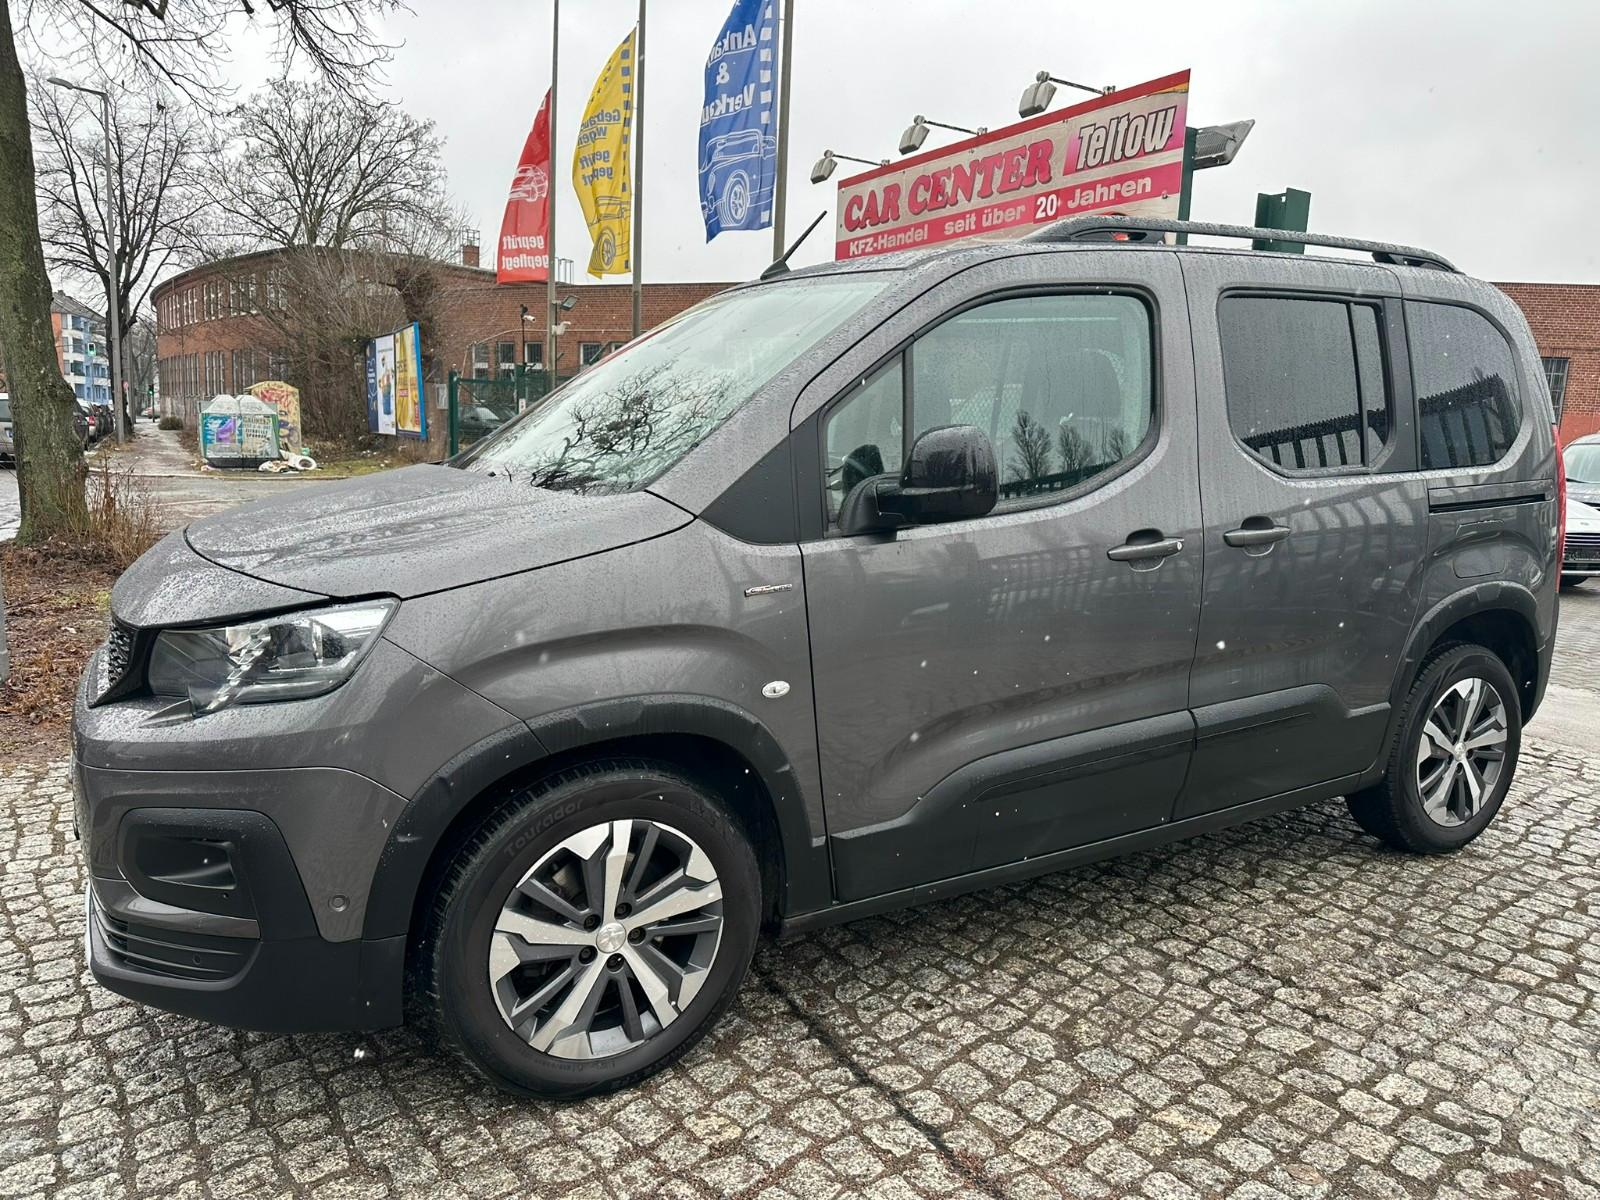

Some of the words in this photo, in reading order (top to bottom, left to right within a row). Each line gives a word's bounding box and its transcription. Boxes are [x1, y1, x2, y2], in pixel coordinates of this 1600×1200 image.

[844, 179, 902, 232] CAR
[907, 138, 1055, 210] CENTER
[1075, 105, 1177, 171] Teltow
[849, 224, 928, 256] KFZ-Handel
[944, 214, 976, 236] seit
[981, 203, 1026, 228] über
[1034, 192, 1060, 221] 20
[1066, 174, 1152, 209] Jahren
[504, 798, 584, 857] Tourador
